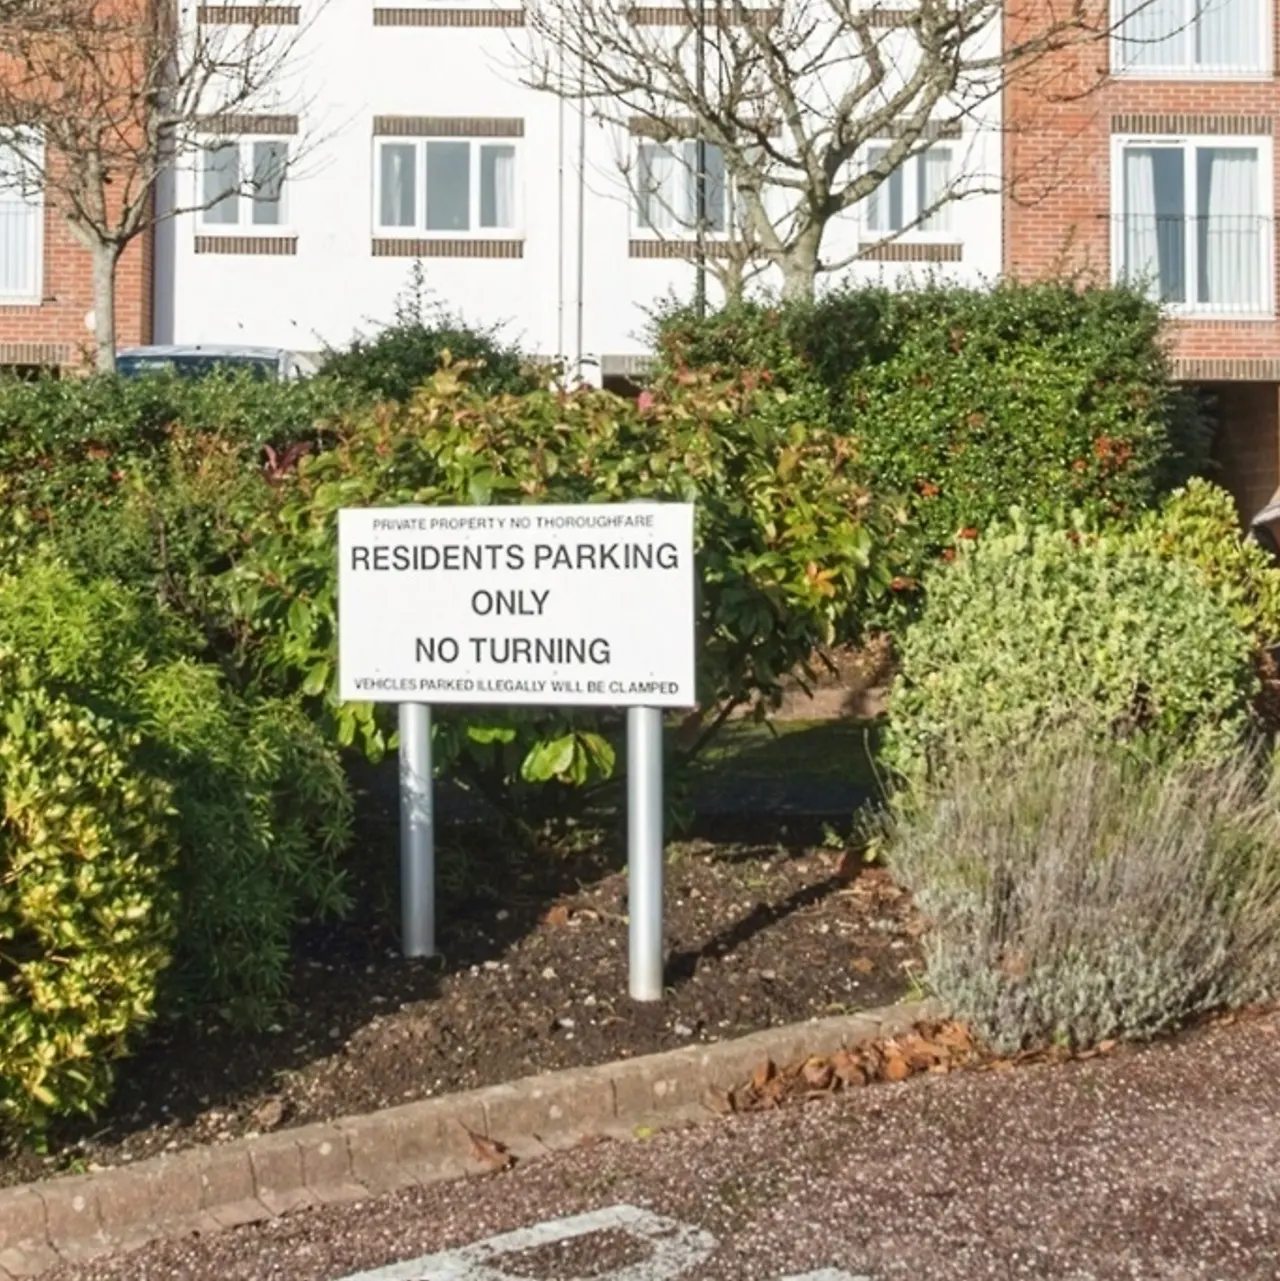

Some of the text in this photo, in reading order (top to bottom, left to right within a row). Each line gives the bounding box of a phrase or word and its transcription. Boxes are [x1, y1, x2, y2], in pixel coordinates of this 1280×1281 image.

[372, 514, 654, 530] PRIVATE PROPERTY NO THOROUGHFARE
[351, 542, 678, 570] RESIDENTS PARKING
[471, 590, 550, 616] ONLY
[415, 637, 611, 664] NO TURNING
[354, 678, 679, 694] VEHICLES PARKED ILLEGALLY WILL BE CLAMPED
